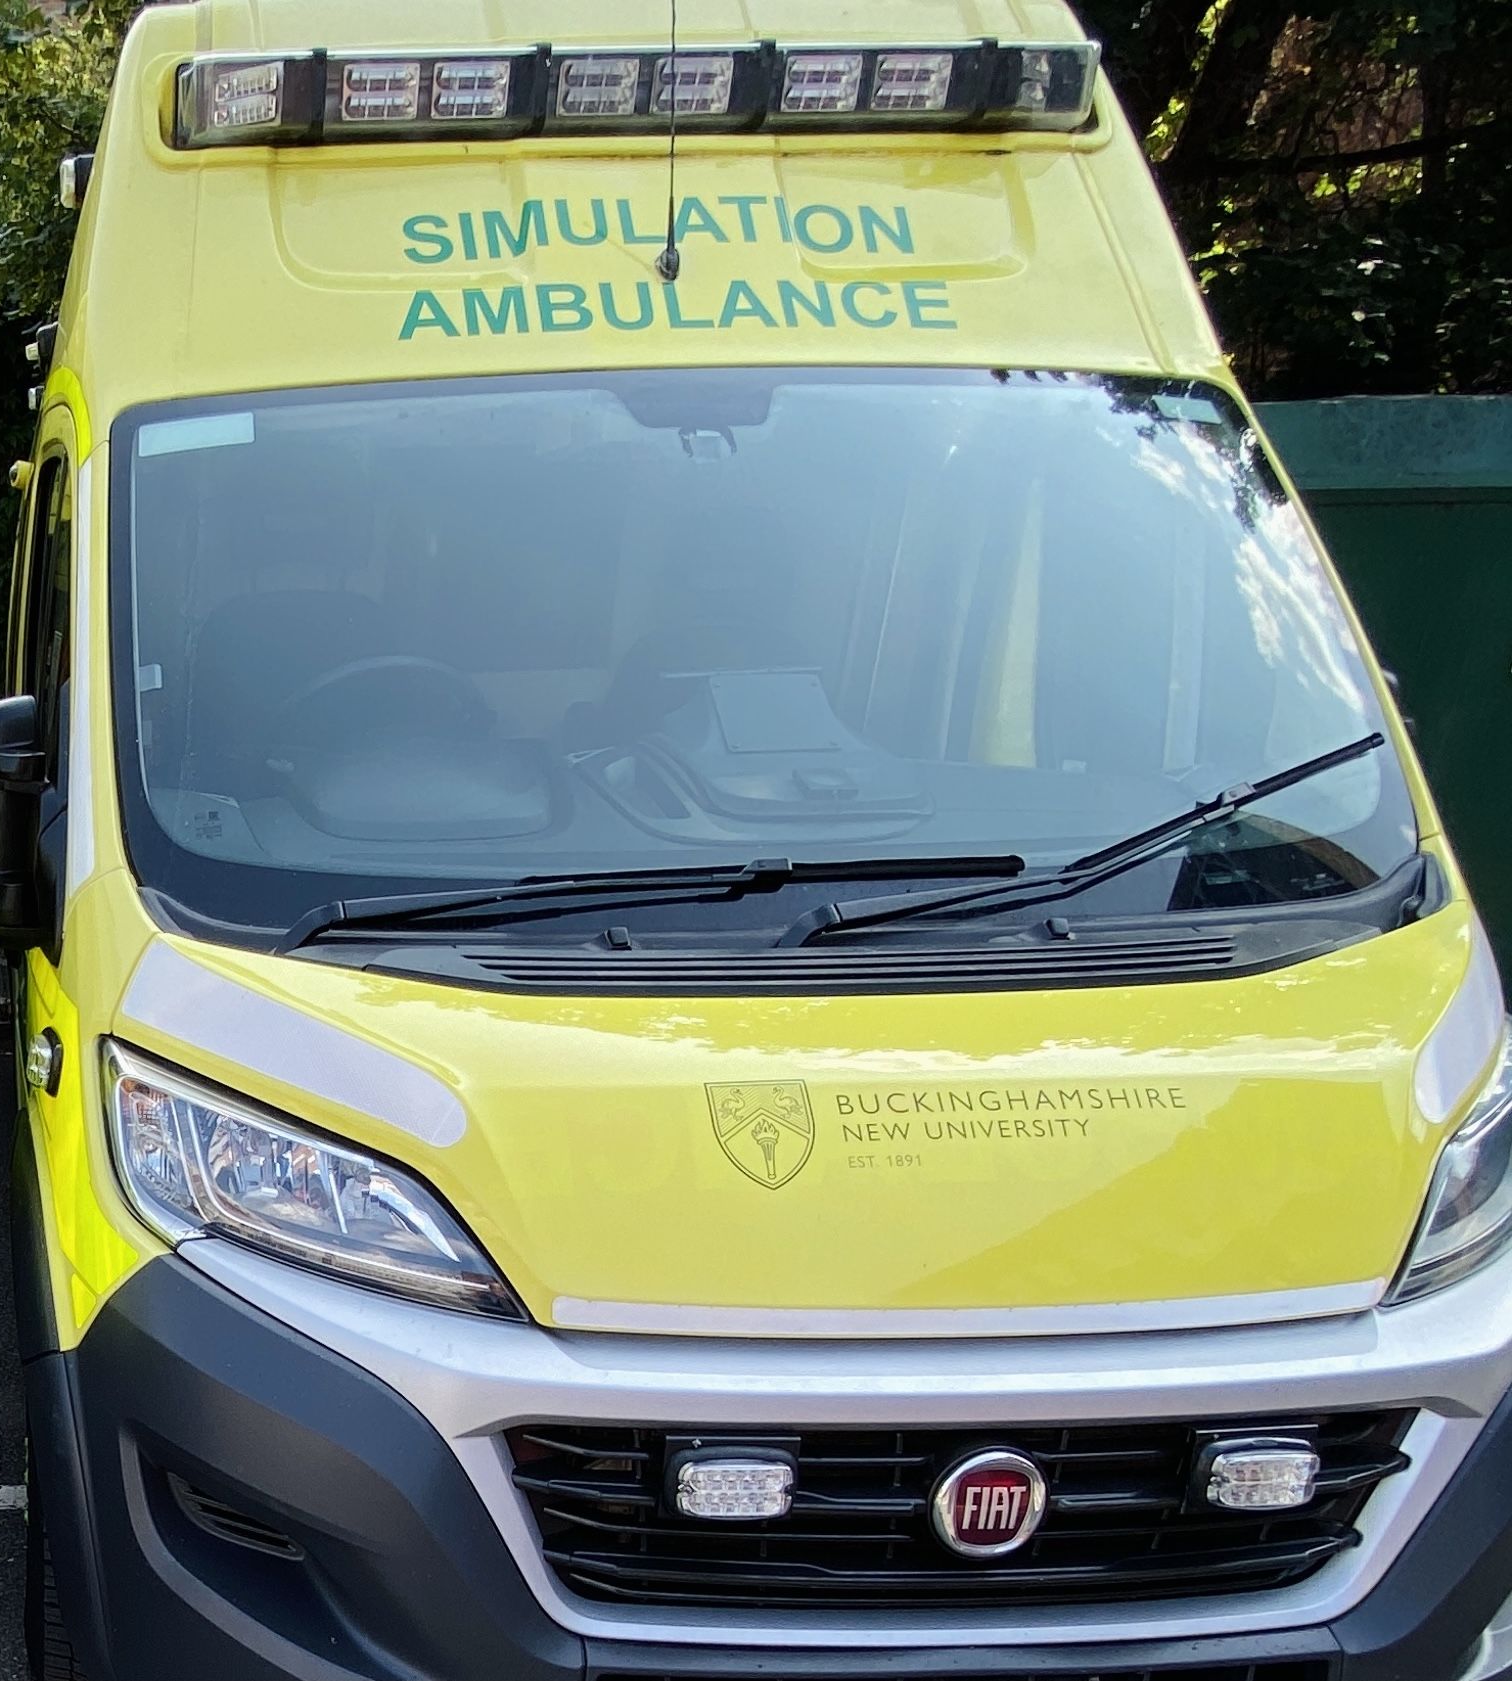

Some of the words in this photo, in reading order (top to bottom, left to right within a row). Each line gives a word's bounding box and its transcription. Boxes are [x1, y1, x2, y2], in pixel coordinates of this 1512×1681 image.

[403, 195, 915, 265] SIMULATION
[397, 280, 958, 340] AMBULANCE
[836, 1087, 1188, 1115] BUCKINGHAMSHIRE
[842, 1122, 912, 1143] NEW
[925, 1118, 1090, 1141] UNIVERSITY
[847, 1155, 879, 1169] EST.
[886, 1153, 923, 1168] 1891
[960, 1485, 1027, 1531] FIAT
